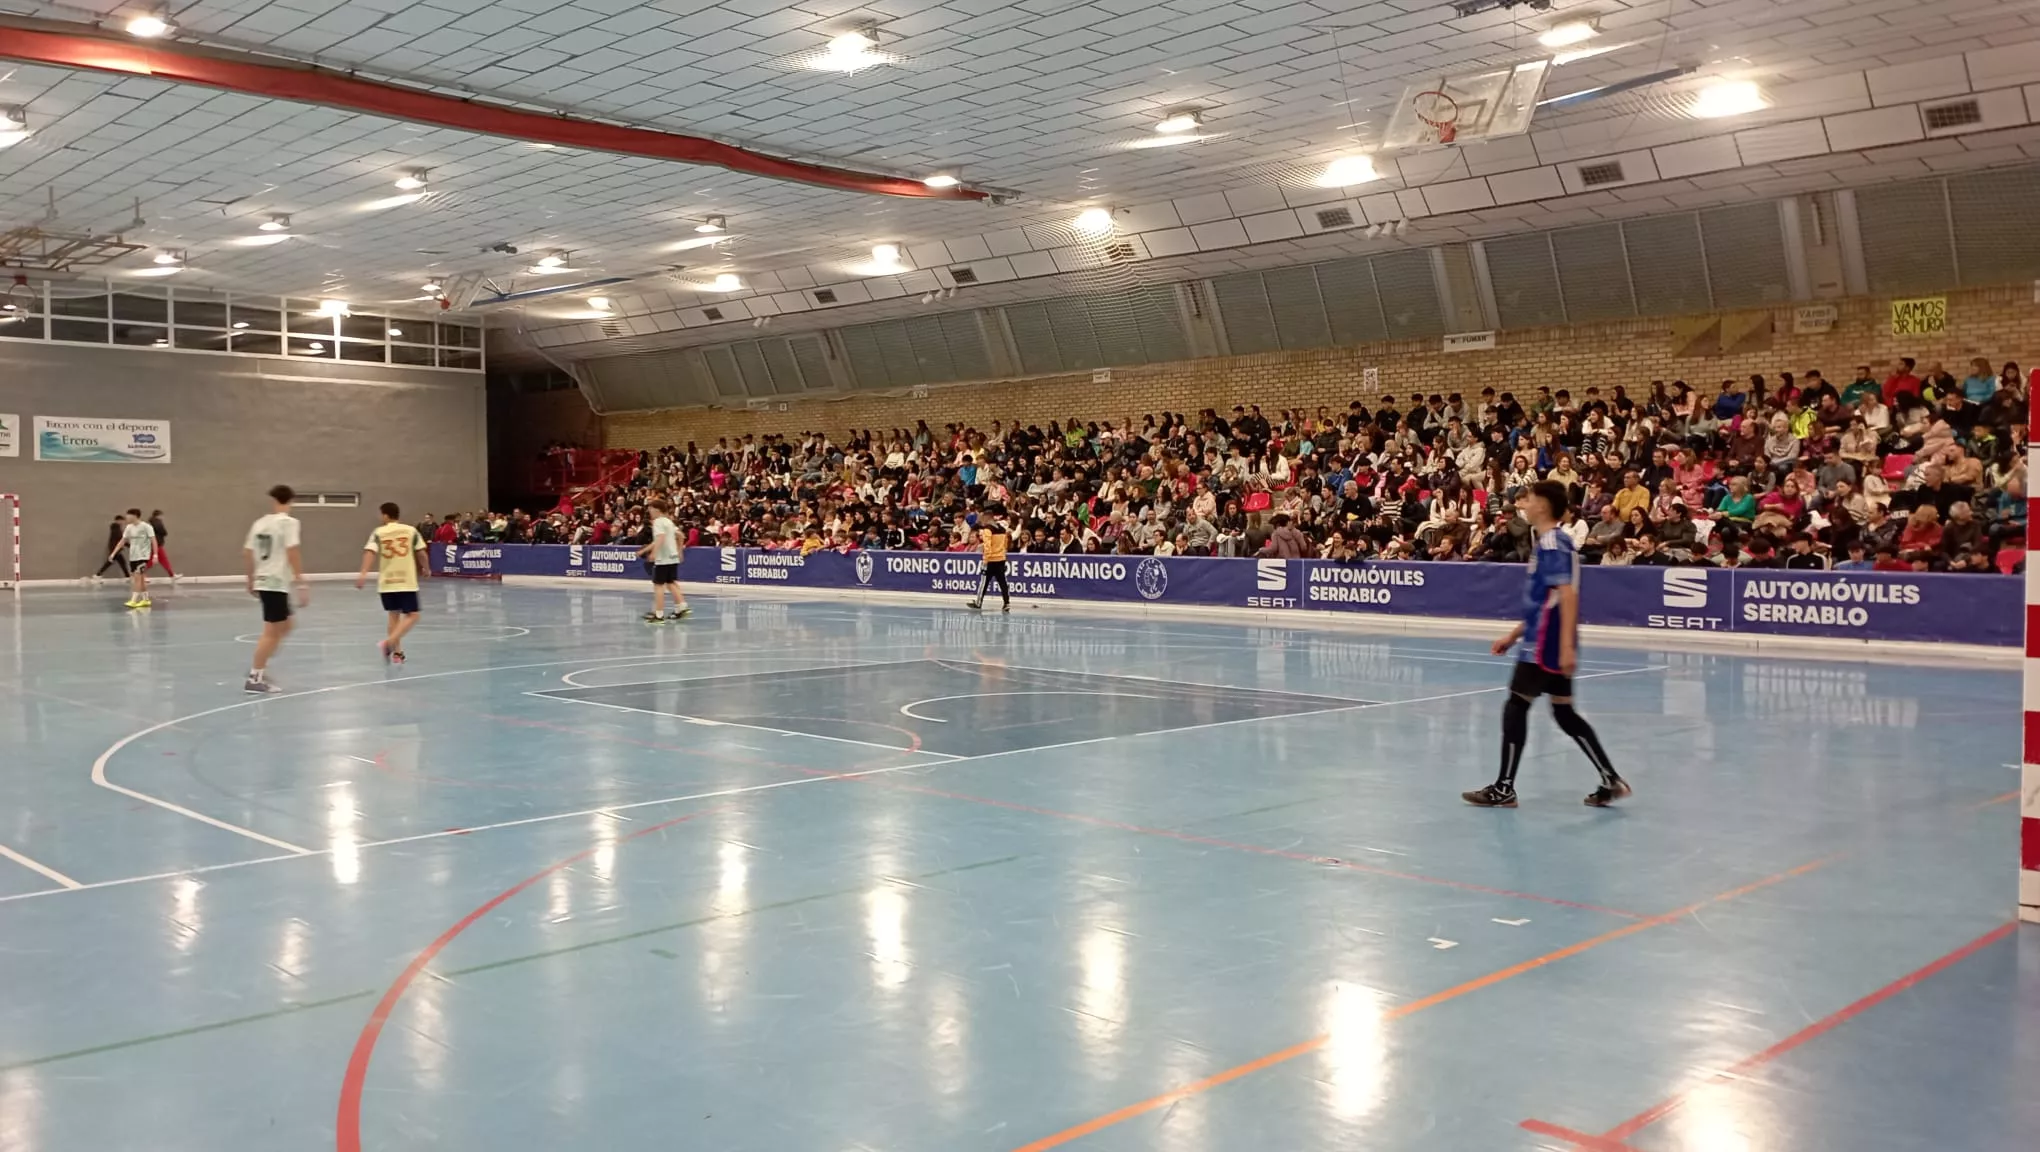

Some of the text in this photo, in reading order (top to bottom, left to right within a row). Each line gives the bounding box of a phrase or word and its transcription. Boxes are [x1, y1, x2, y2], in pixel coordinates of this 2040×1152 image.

[1894, 301, 1944, 319] VAMOS
[45, 420, 159, 433] Ercros con el deporte
[61, 434, 99, 446] Ercros
[380, 536, 410, 559] 33
[591, 549, 637, 561] AUTOMÓVILES
[747, 552, 805, 567] AUTOMÓVILES
[591, 563, 625, 573] SERRABLO
[747, 567, 788, 580] SERRABLO
[886, 557, 941, 574] TORNEO
[1023, 558, 1127, 581] SABIÑANIGO
[1310, 565, 1425, 586] AUTOMÓVILES
[715, 575, 742, 584] SEAT
[931, 579, 943, 590] 36
[945, 579, 977, 591] HORAS
[1030, 582, 1056, 594] SALA
[1310, 586, 1391, 604] SERRABLO
[1743, 577, 1921, 605] AUTOMÓVILES
[1247, 596, 1297, 608] SEAT
[1647, 614, 1723, 630] SEAT
[1743, 604, 1869, 626] SERRABLO
